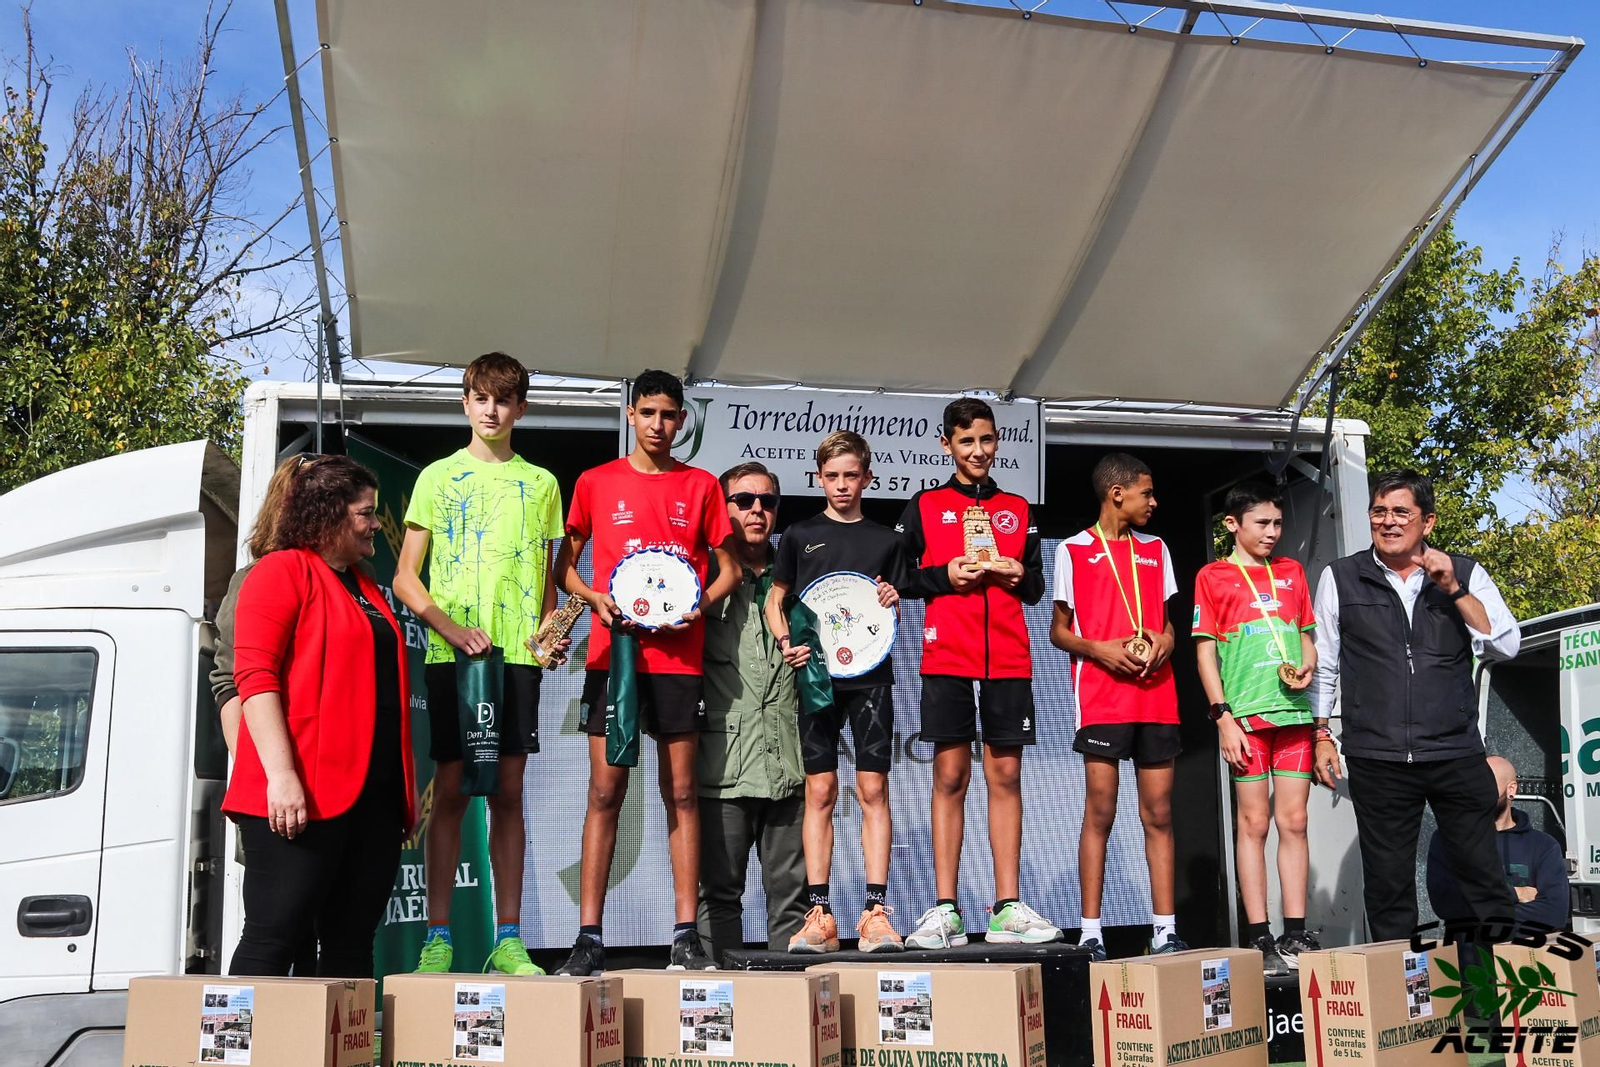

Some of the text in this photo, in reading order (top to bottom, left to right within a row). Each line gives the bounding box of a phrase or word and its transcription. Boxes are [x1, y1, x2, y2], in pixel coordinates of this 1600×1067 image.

[740, 443, 806, 460] ACEITE
[888, 476, 911, 492] 57
[1330, 980, 1355, 996] MUY
[1120, 992, 1145, 1008] MUY
[1326, 1000, 1364, 1017] FRAGIL
[349, 1008, 367, 1028] MUY
[1116, 1012, 1153, 1030] FRAGIL
[343, 1030, 371, 1052] FRAGIL
[596, 1028, 621, 1050] FRAGIL
[821, 1022, 839, 1043] FRAGIL
[1327, 1027, 1366, 1039] CONTIENE
[1377, 1026, 1398, 1050] ACEITE
[1398, 1024, 1407, 1045] DE
[1116, 1041, 1154, 1053] CONTIENE
[1166, 1025, 1264, 1065] ACEITE DE OLIVA VIRGEN EXTRA
[1328, 1038, 1367, 1049] 3 Garrafas
[859, 1048, 876, 1067] DE
[878, 1049, 914, 1067] OLIVA
[916, 1051, 963, 1067] VIRGEN
[966, 1053, 1009, 1067] EXTRA
[1117, 1052, 1154, 1063] 3 Garrafas
[1333, 1048, 1363, 1059] de 5 Lts.
[1531, 1057, 1574, 1067] ACEITE DE
